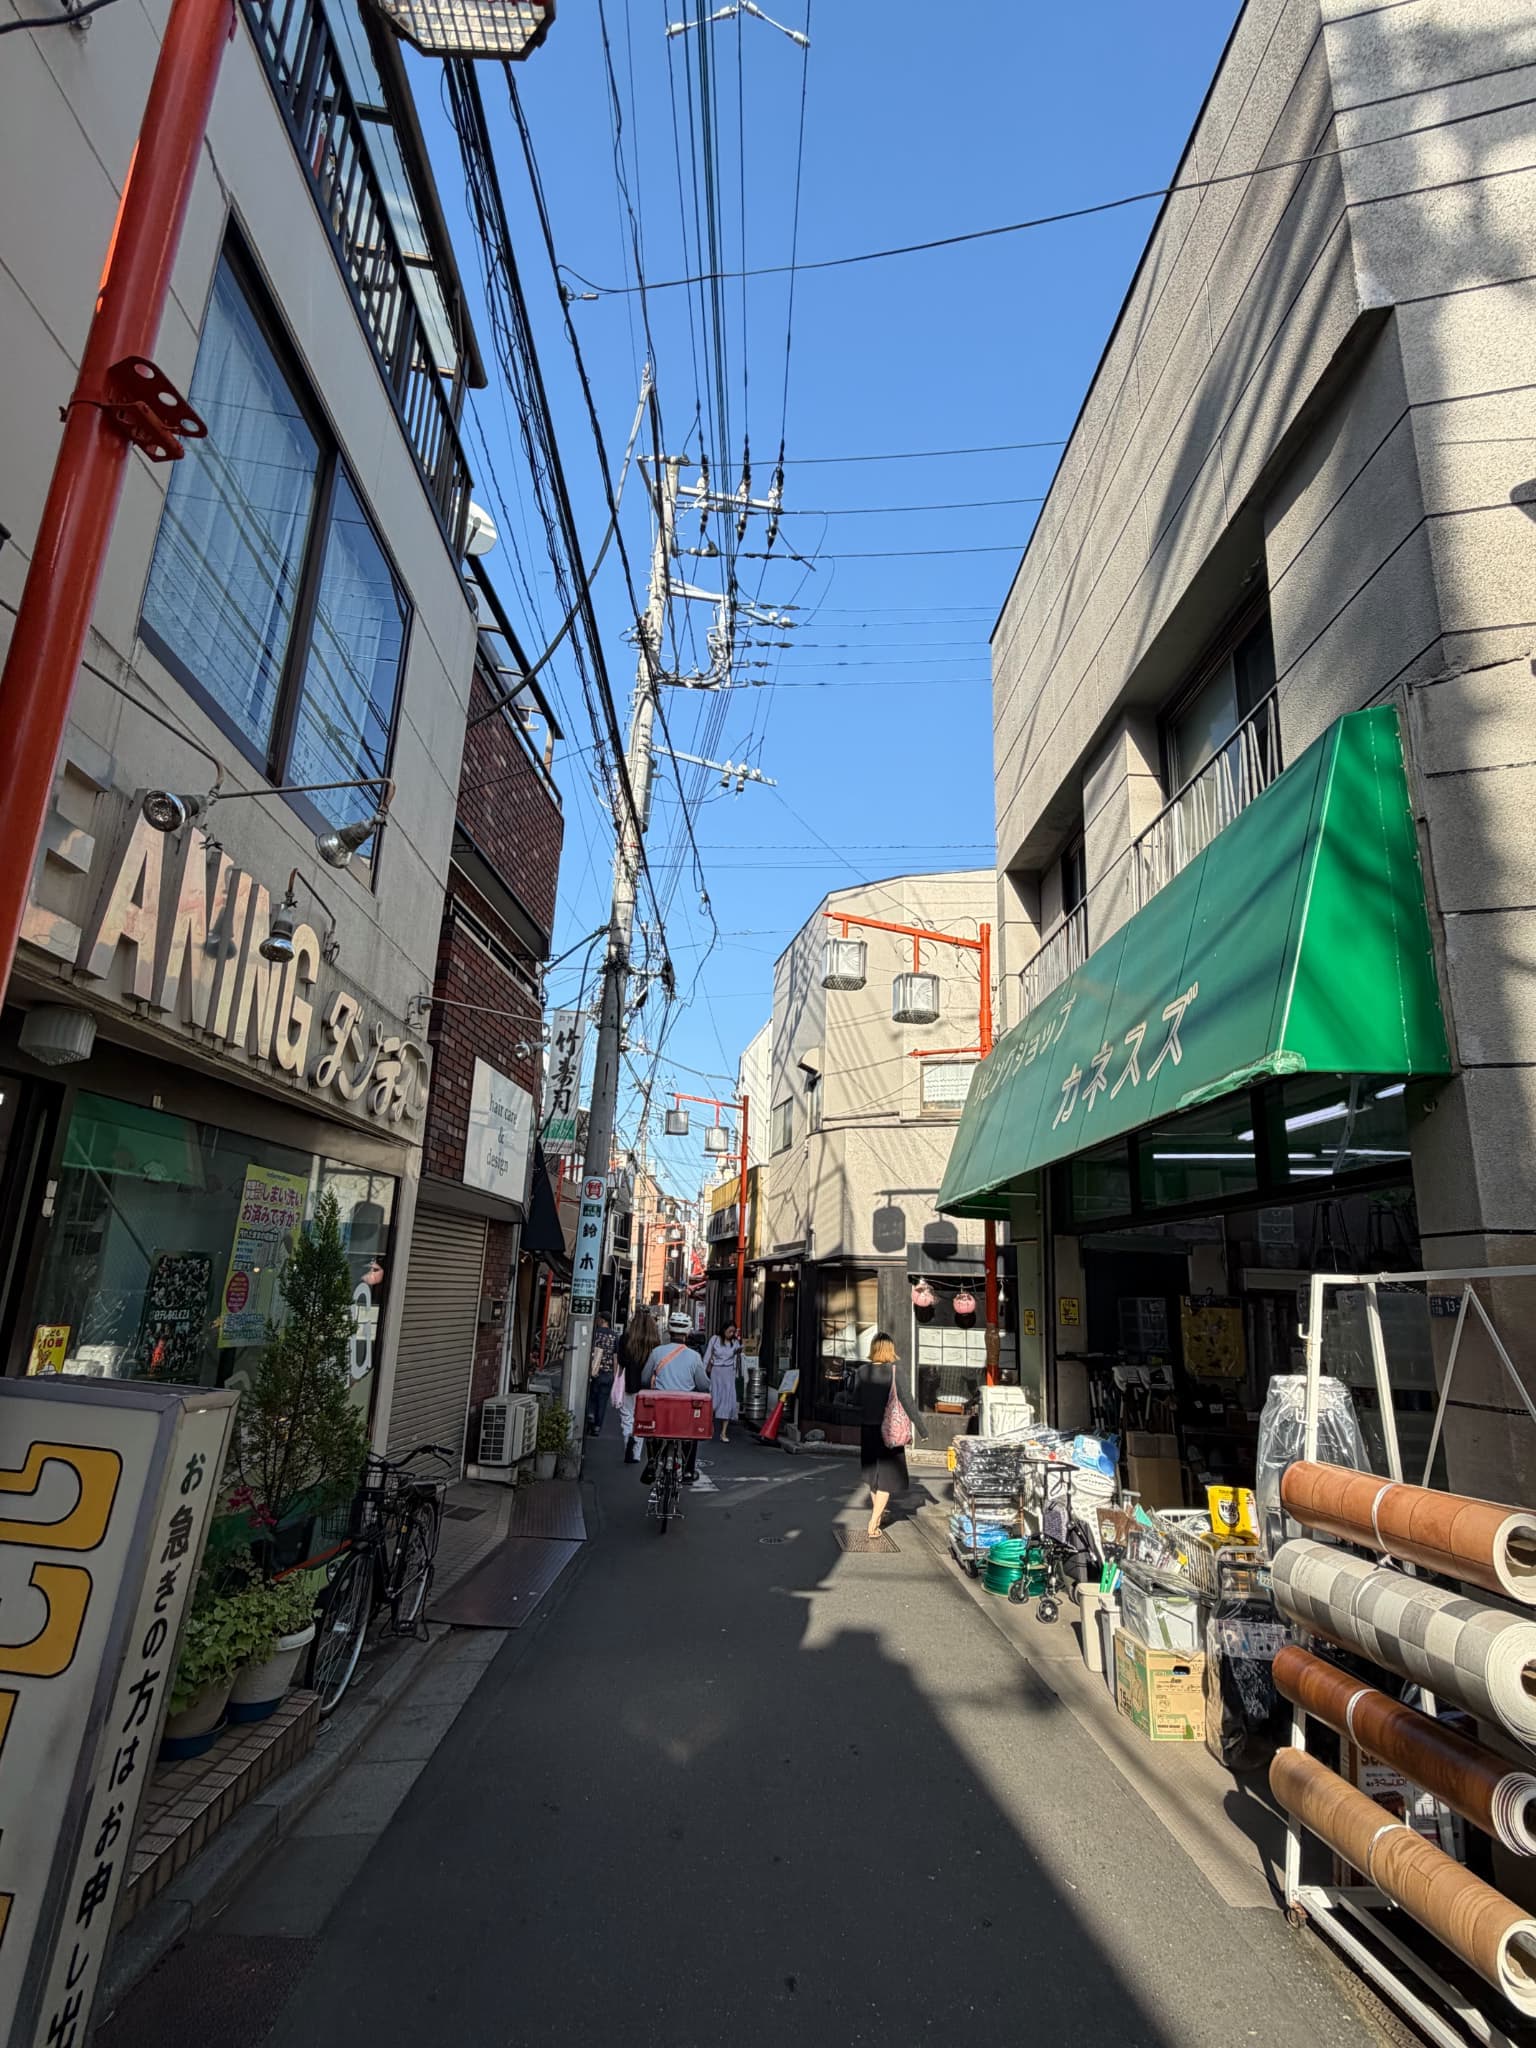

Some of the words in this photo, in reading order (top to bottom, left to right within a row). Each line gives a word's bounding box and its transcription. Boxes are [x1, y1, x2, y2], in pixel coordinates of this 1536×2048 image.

[973, 992, 1078, 1107] リビングショップ
[1052, 981, 1199, 1131] カネスズ
[489, 1092, 503, 1119] hair
[504, 1105, 518, 1126] care
[497, 1126, 505, 1145] &
[487, 1145, 509, 1177] design
